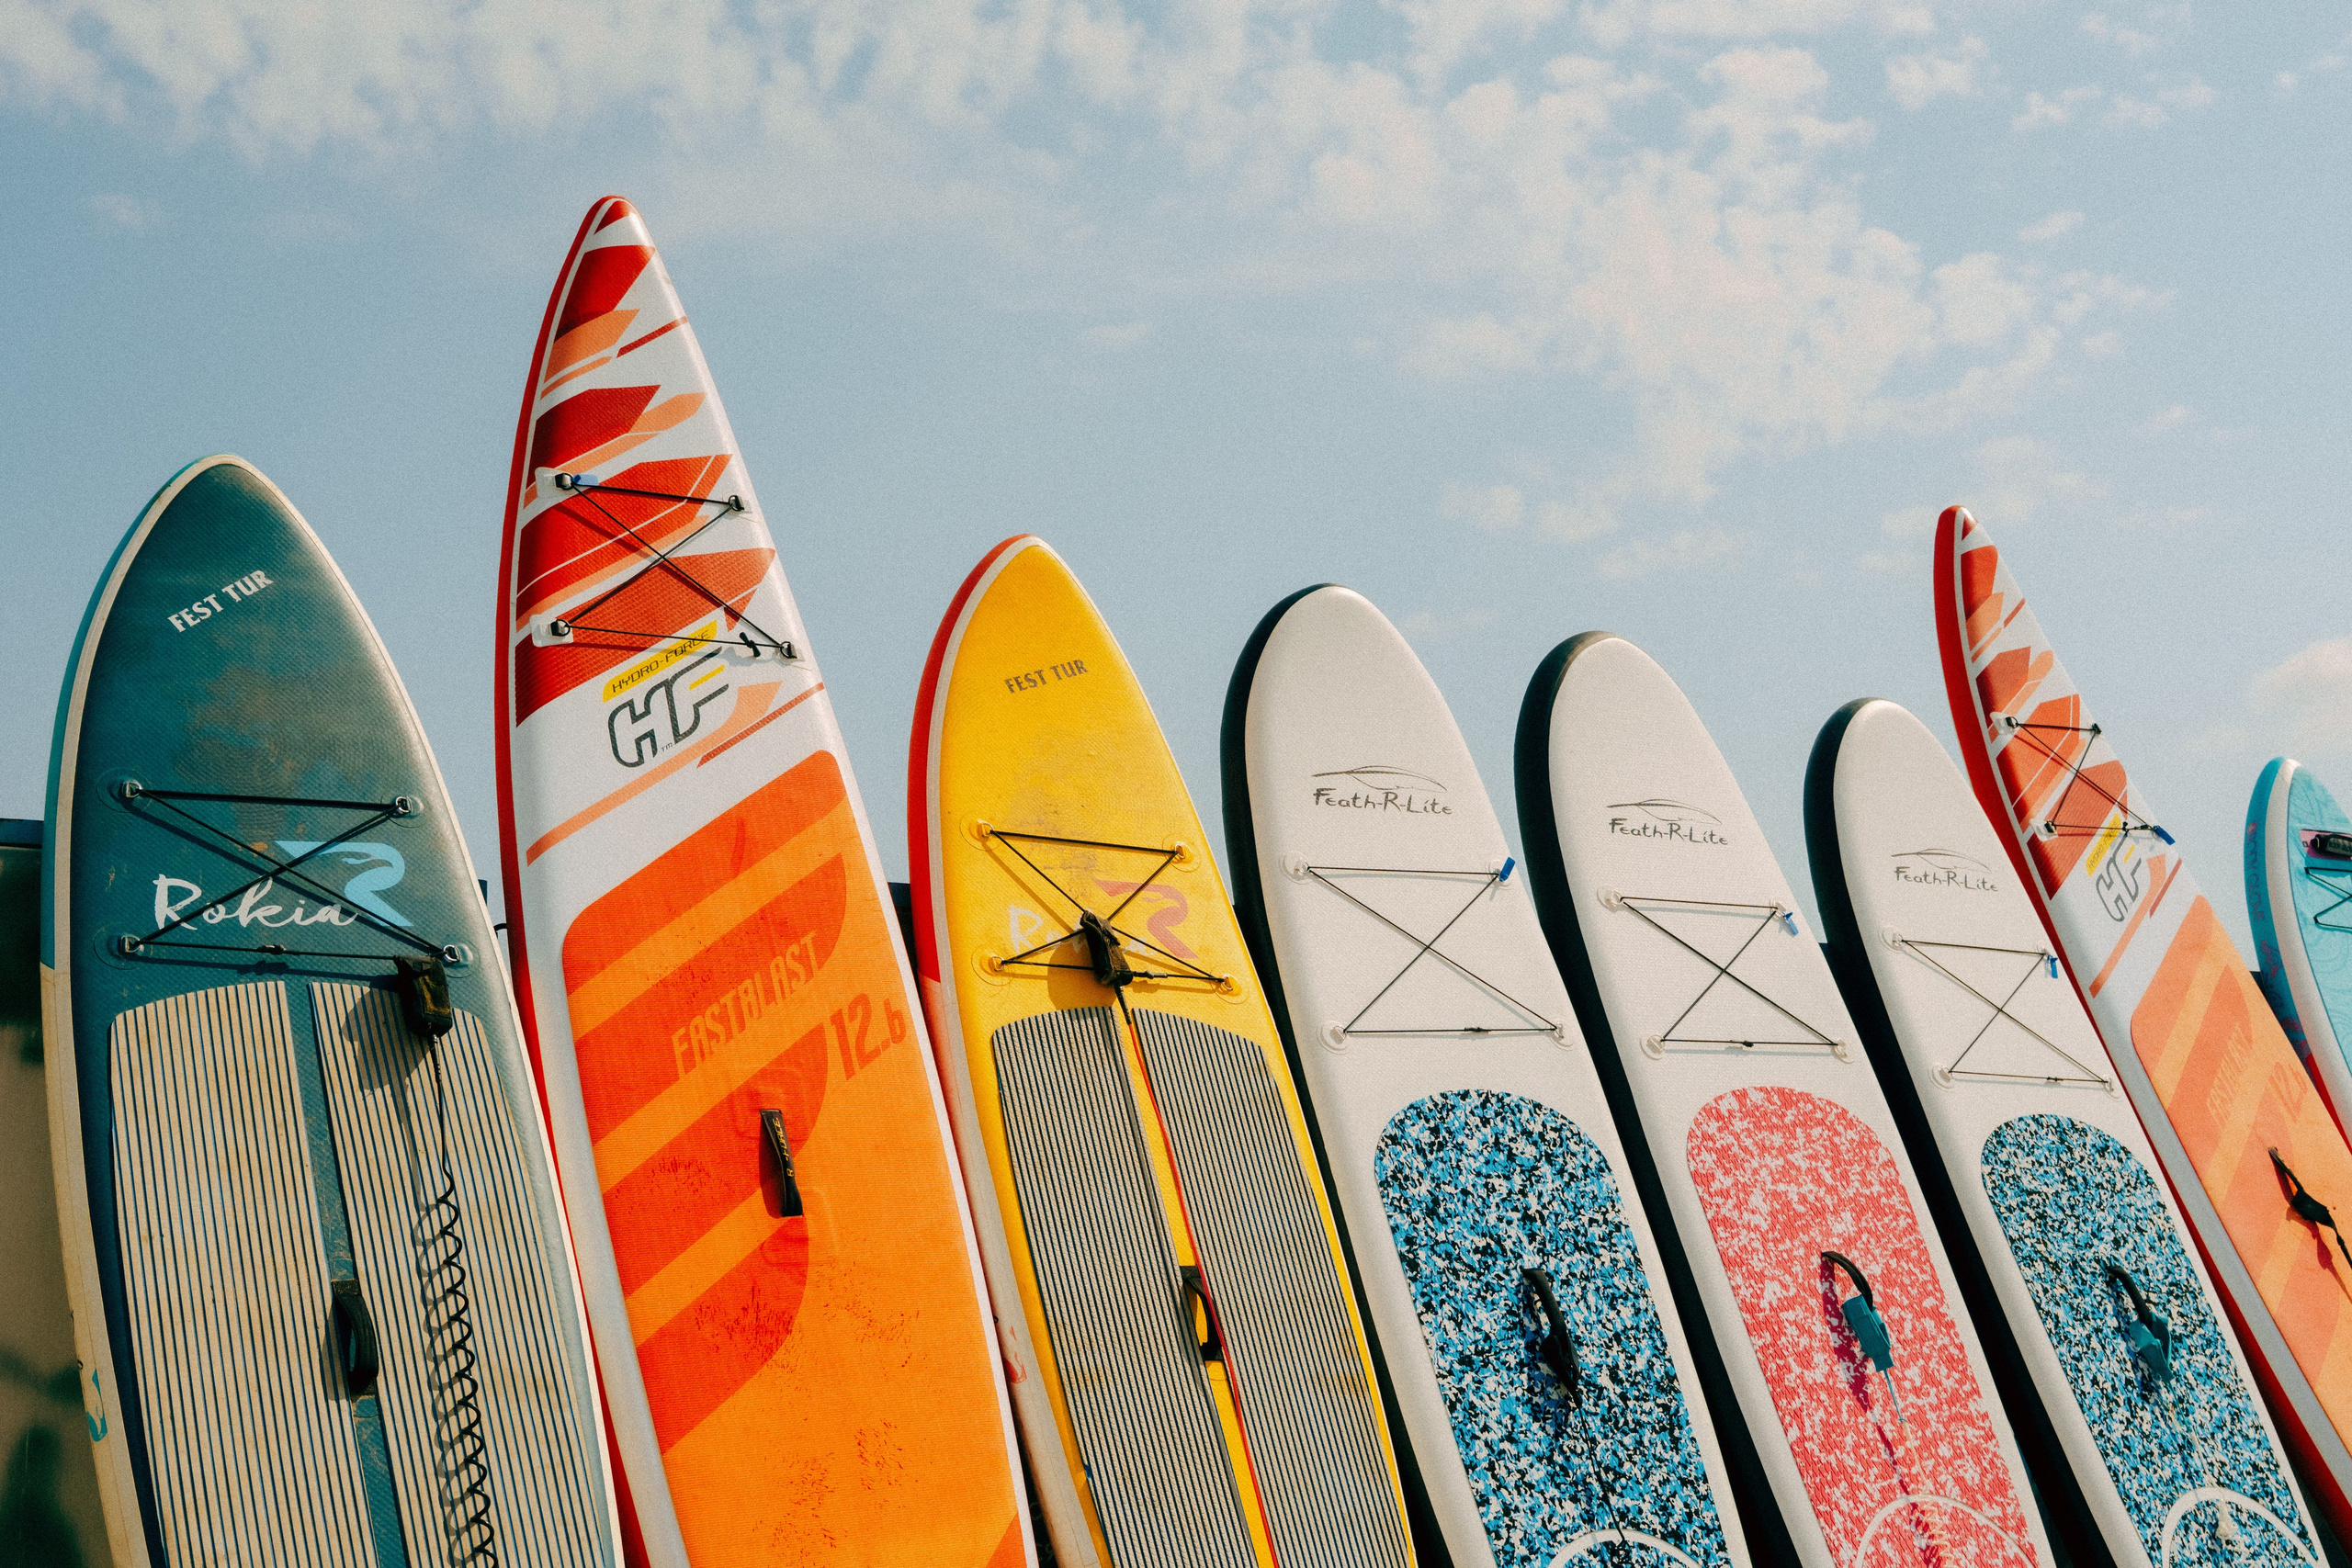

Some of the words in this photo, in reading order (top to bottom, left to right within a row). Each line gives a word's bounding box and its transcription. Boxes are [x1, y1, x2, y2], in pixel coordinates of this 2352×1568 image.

[167, 593, 224, 633] FEST
[221, 570, 274, 603] TUR
[612, 629, 710, 693] HYDRO-FORCE
[1004, 669, 1046, 694] FEST
[1049, 659, 1089, 681] TUR
[1312, 787, 1453, 816] Feath-R-Lite
[1608, 818, 1729, 846] Feath-R-Lite
[1894, 866, 1999, 892] Feath-R-Lite
[153, 874, 359, 931] Rokia
